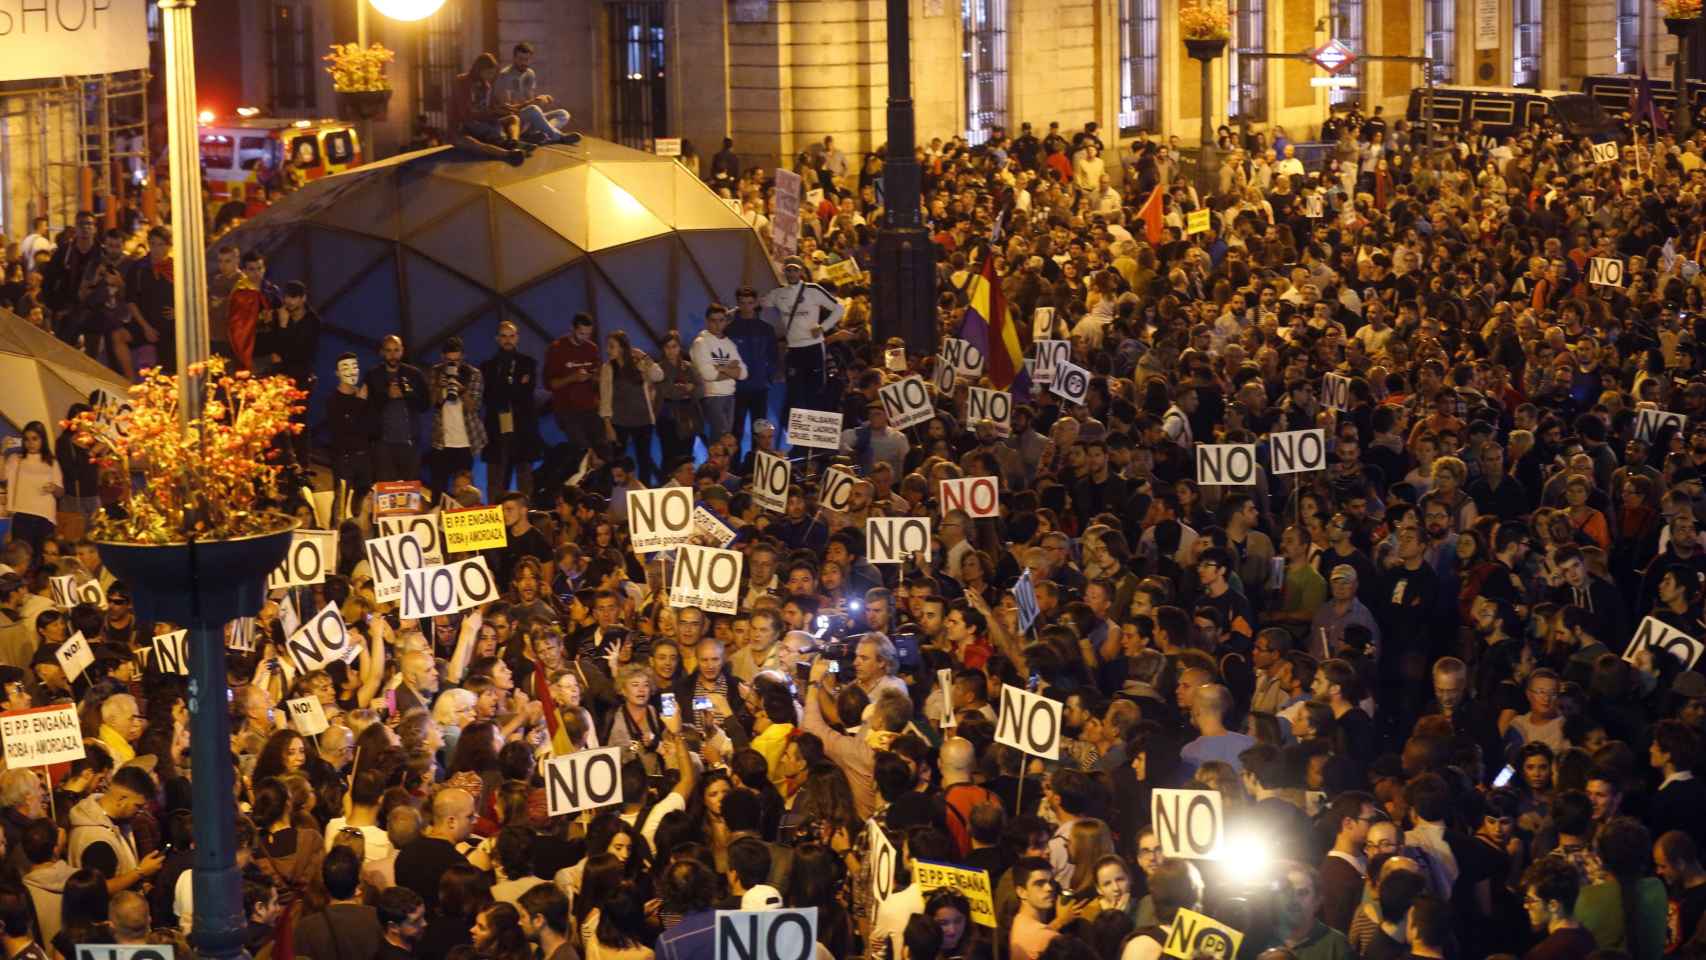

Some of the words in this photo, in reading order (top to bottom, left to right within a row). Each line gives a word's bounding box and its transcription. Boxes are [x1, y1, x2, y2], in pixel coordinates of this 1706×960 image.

[1594, 143, 1616, 159] NO
[1591, 258, 1620, 284] NO
[945, 340, 981, 369] NO
[1037, 342, 1068, 369] NO
[880, 378, 924, 417] NO
[971, 388, 1008, 422] NO
[1326, 376, 1348, 408] NO
[1199, 446, 1253, 483] NO
[1272, 432, 1322, 472] NO
[756, 453, 788, 496] NO
[630, 489, 691, 535] NO
[943, 479, 996, 515] NO
[370, 535, 422, 584] NO
[870, 519, 927, 561] NO
[272, 541, 320, 586] NO
[457, 561, 491, 606] O
[676, 547, 738, 594] NO
[79, 584, 101, 606] O
[405, 568, 454, 615] NO
[63, 641, 80, 661] NO!
[289, 610, 344, 674] NO
[1627, 619, 1695, 664] NO
[293, 702, 313, 714] NO!
[1001, 688, 1057, 753] NO
[549, 754, 618, 811] NO
[1156, 794, 1216, 853] NO
[720, 912, 813, 960] NO
[1168, 914, 1234, 960] NO
